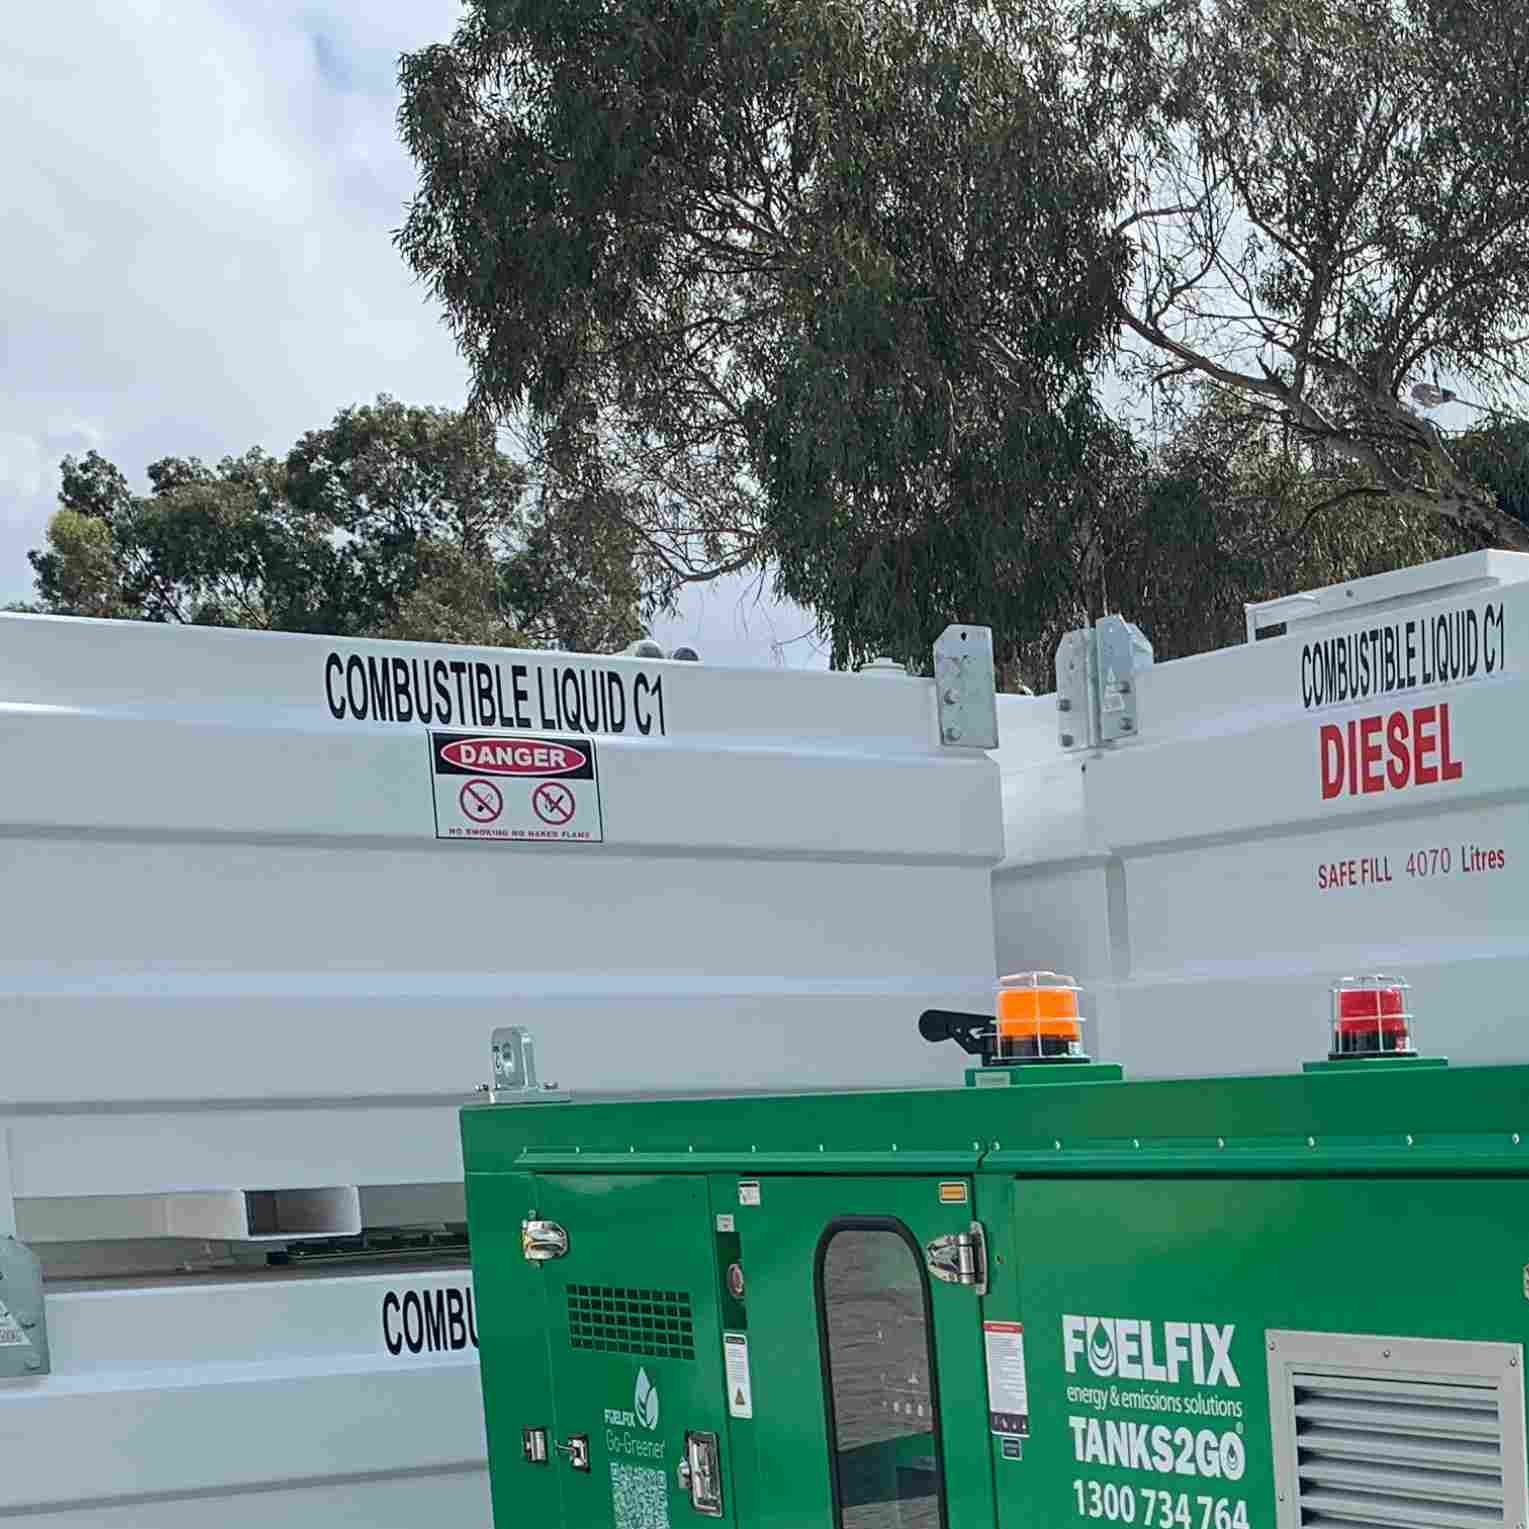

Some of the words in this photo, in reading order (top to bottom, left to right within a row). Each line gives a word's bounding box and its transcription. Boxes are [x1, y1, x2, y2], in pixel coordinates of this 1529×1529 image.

[1302, 621, 1416, 709] COMBUSTIBLE
[1421, 608, 1478, 685] LIQUID
[1484, 602, 1505, 674] C1
[325, 652, 532, 729] COMBUSTIBLE
[537, 666, 626, 735] LIQUID
[634, 673, 666, 736] C1
[460, 744, 567, 768] DANGER
[1320, 702, 1463, 801] DIESEL
[1318, 860, 1357, 889] SAFE
[1361, 856, 1392, 886] FILL
[1405, 848, 1451, 878] 4070
[1461, 845, 1505, 873] Litres
[1062, 1314, 1241, 1387] FUELFIX
[1067, 1385, 1109, 1410] energy
[1110, 1385, 1121, 1406] &
[1122, 1388, 1183, 1413] emissions
[1184, 1391, 1243, 1418] solutions
[1068, 1415, 1246, 1481] TANKS2GO
[1073, 1479, 1136, 1523] 1300
